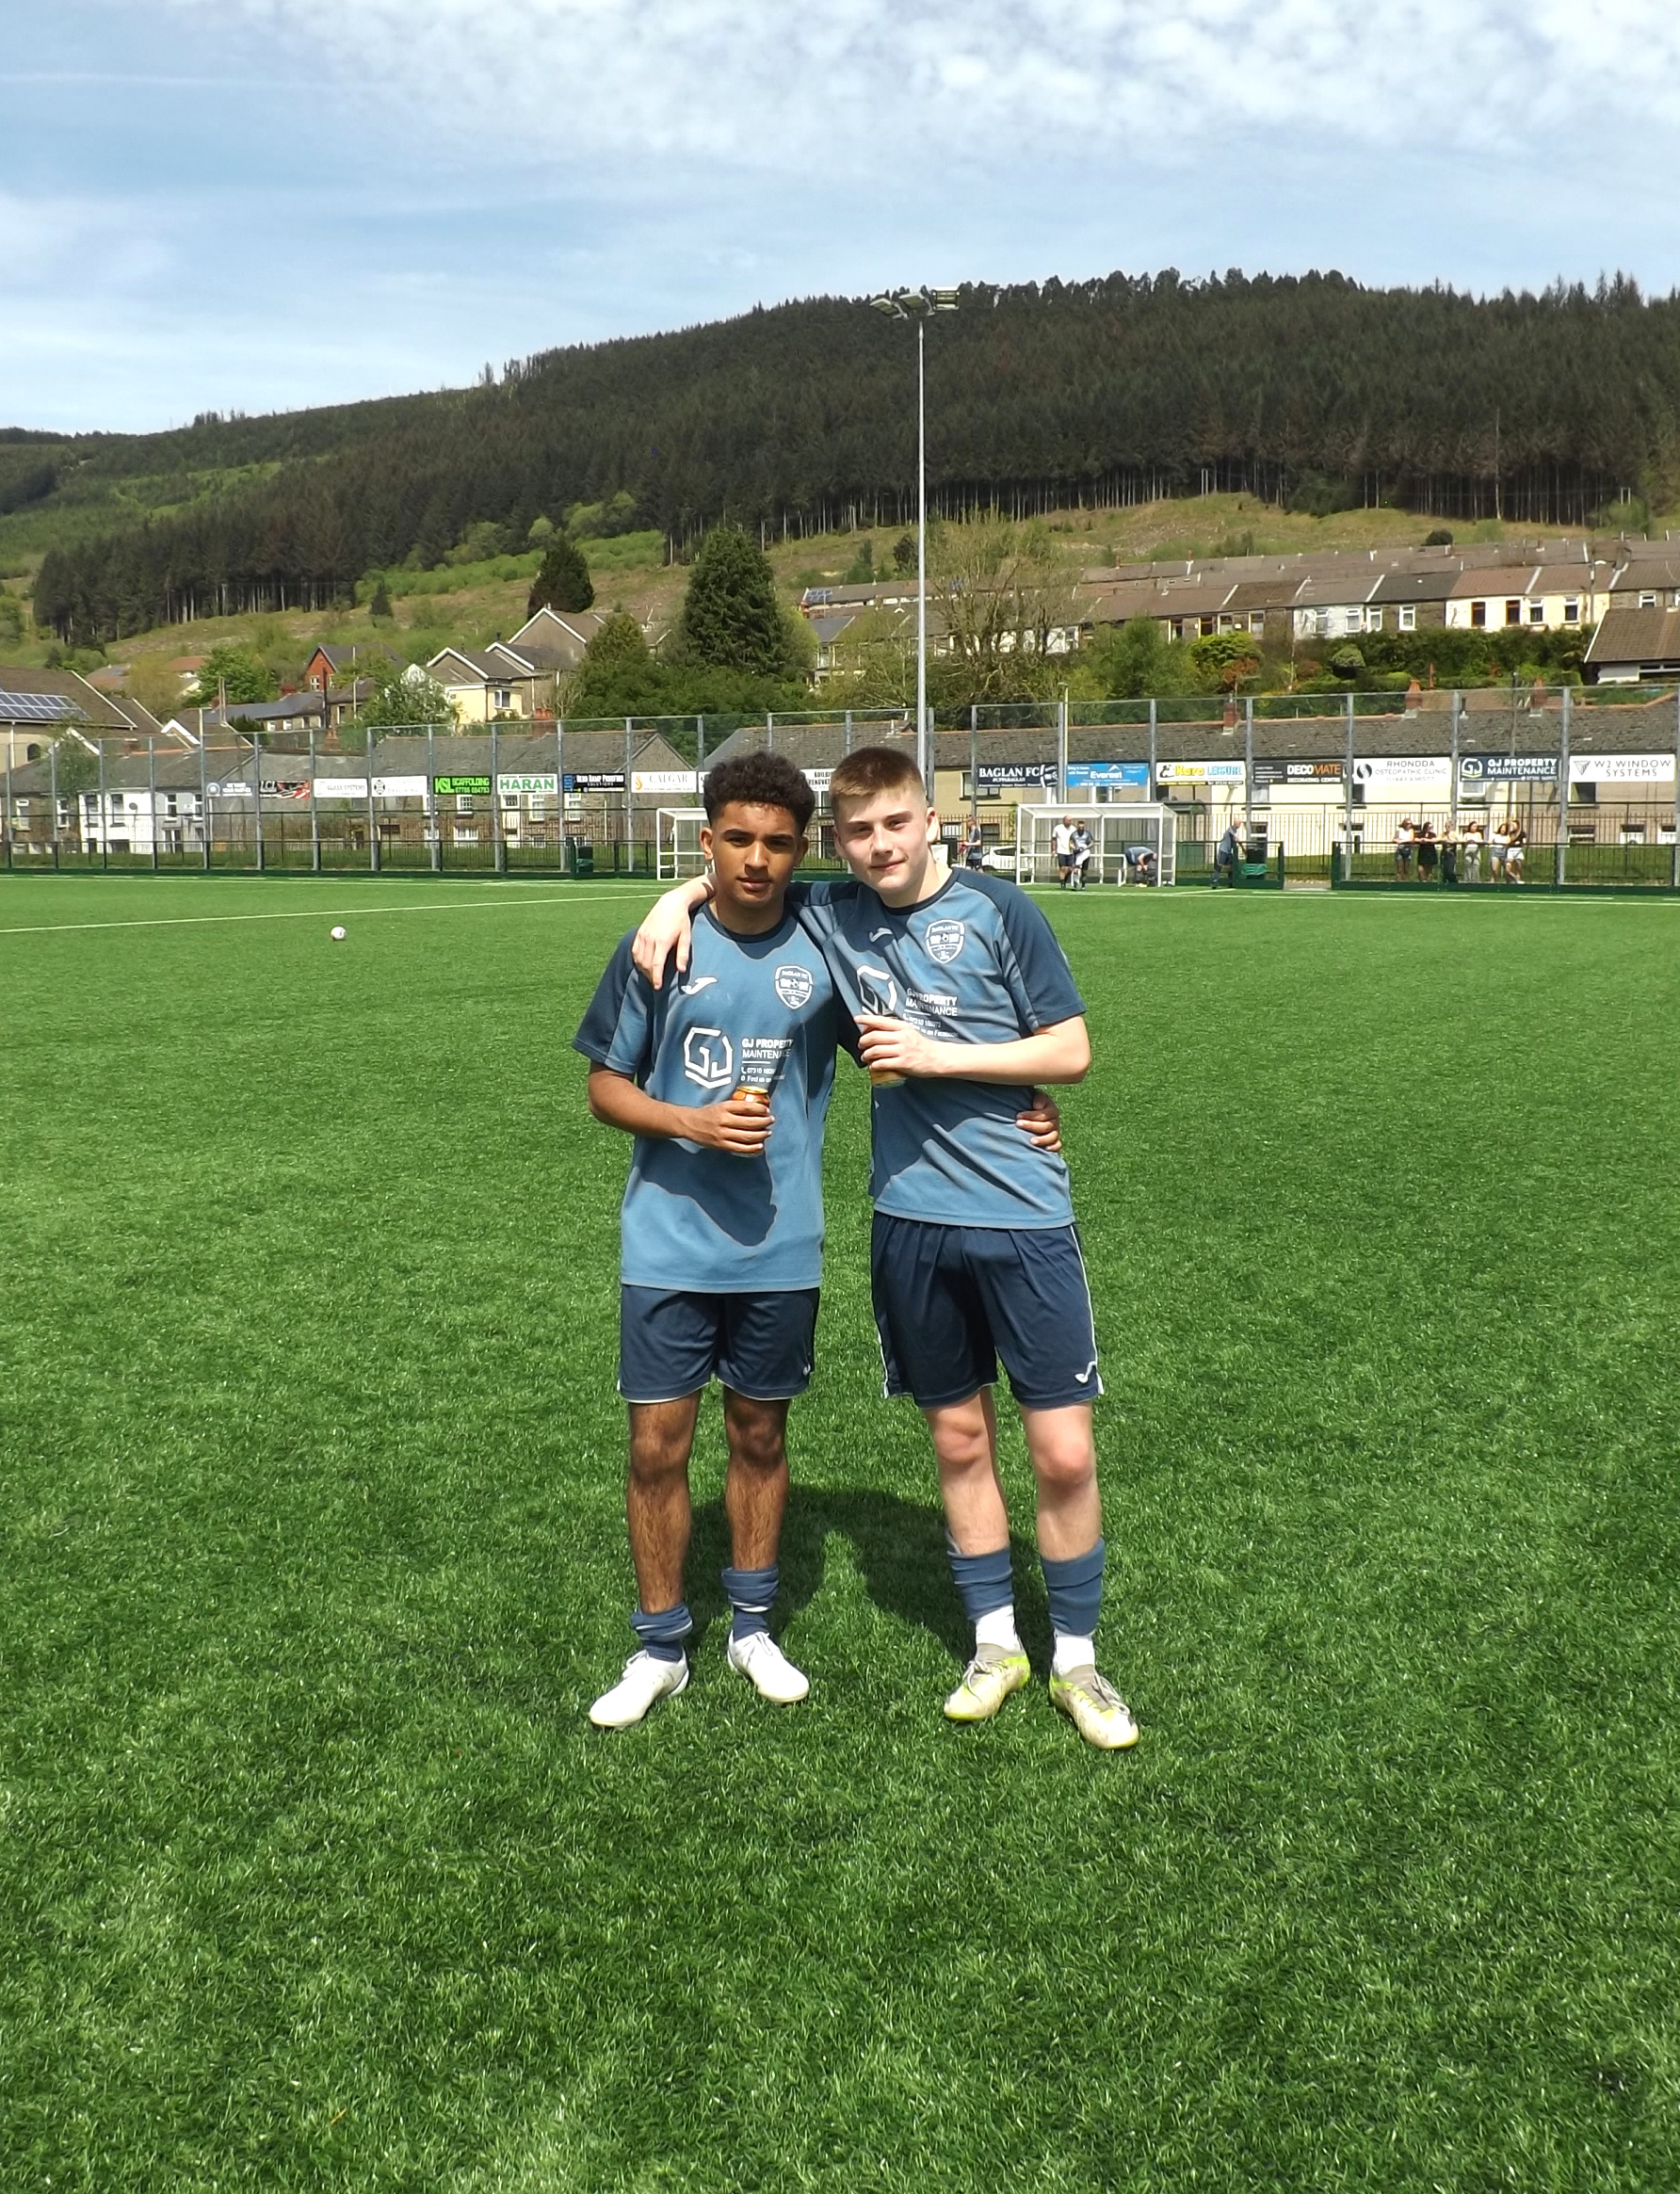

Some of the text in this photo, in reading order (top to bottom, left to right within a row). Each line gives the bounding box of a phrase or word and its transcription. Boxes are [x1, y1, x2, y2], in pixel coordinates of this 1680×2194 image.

[1487, 758, 1557, 767] GJ PROPERTY
[1615, 760, 1672, 768] WINDOW
[978, 766, 1023, 778] BAGLAN
[1026, 766, 1040, 777] FC
[1090, 770, 1123, 779] Everest
[1207, 766, 1242, 775] LEISURE
[1487, 766, 1557, 775] MAINTENANCE
[1606, 768, 1657, 777] SYSTEMS
[434, 777, 455, 794] KSL
[451, 777, 490, 786] SCAFFOLDING
[499, 778, 555, 790] HARAN
[742, 1038, 754, 1048] GJ
